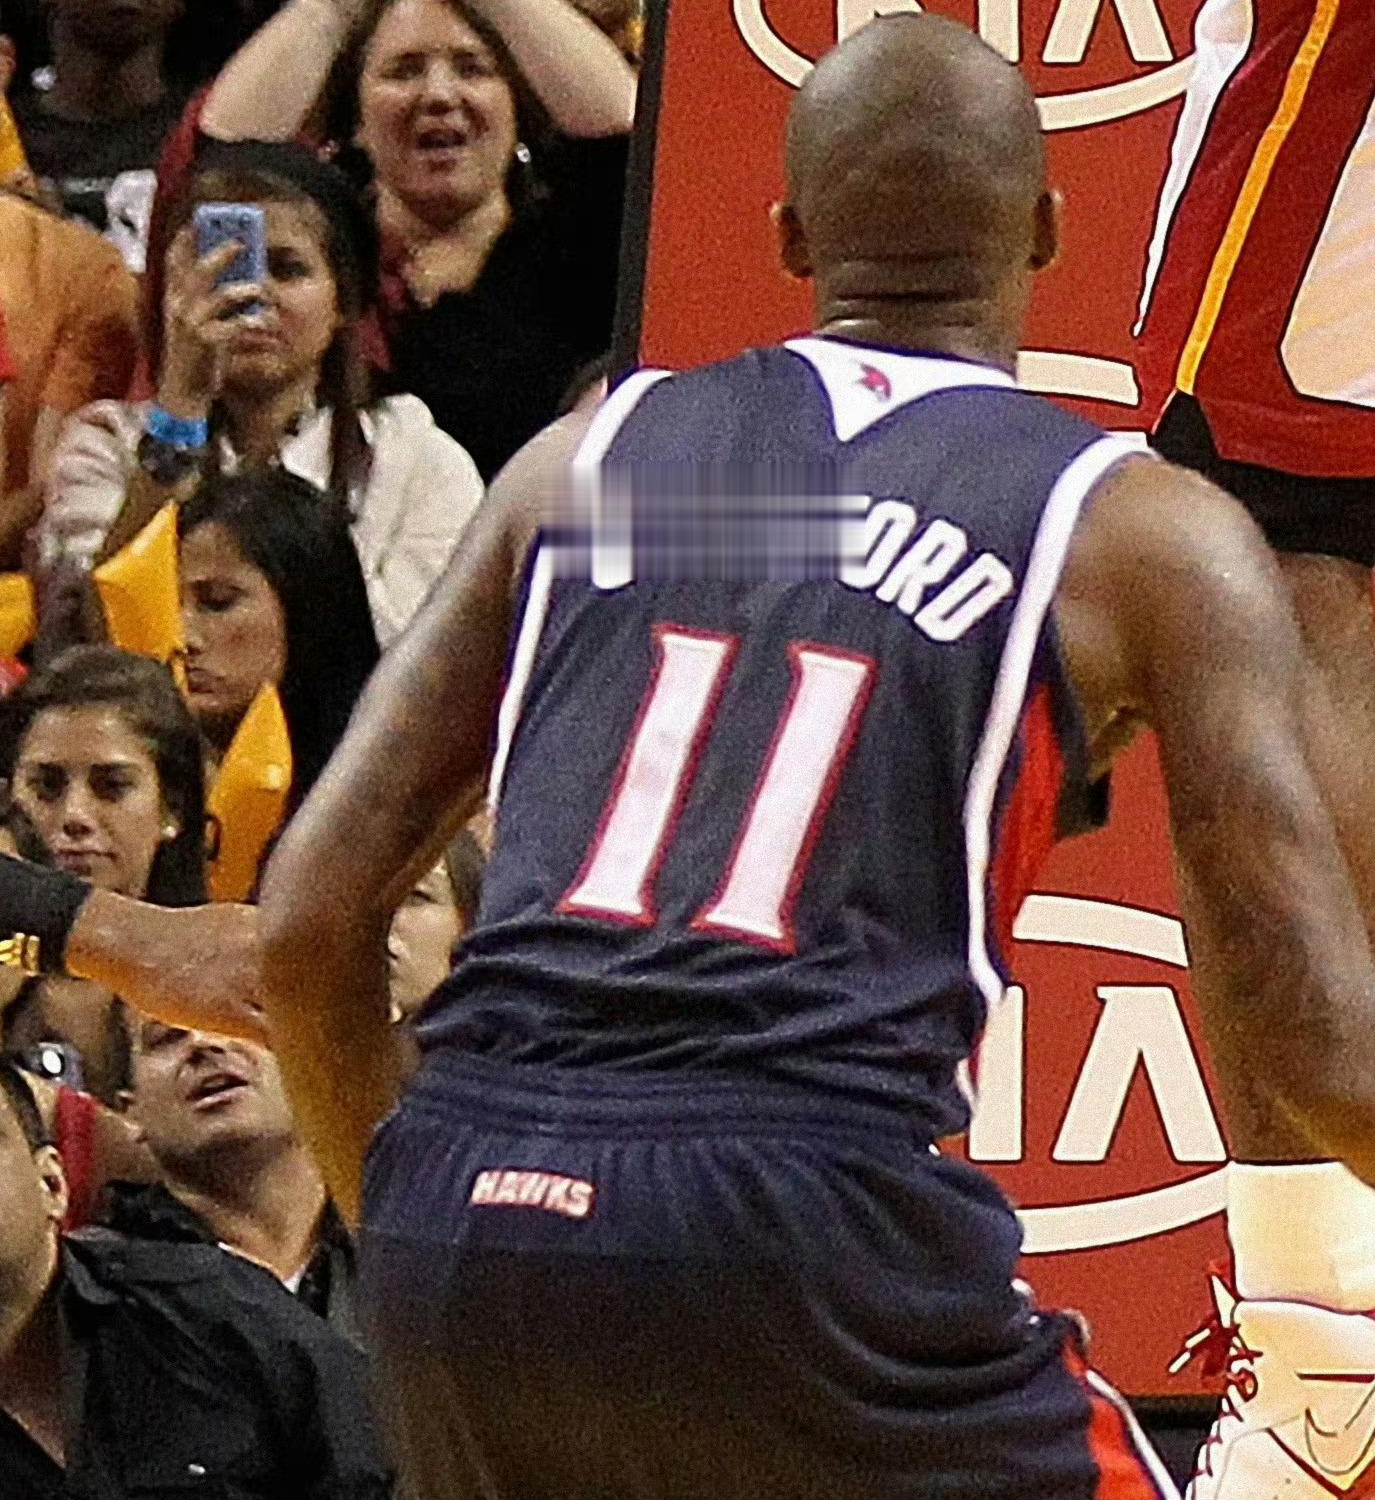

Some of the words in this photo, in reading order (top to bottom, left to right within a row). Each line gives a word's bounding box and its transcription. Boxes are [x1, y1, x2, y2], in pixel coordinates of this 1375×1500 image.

[554, 622, 879, 957] 11
[968, 985, 1228, 1162] IA
[471, 1168, 594, 1217] HAWKS
